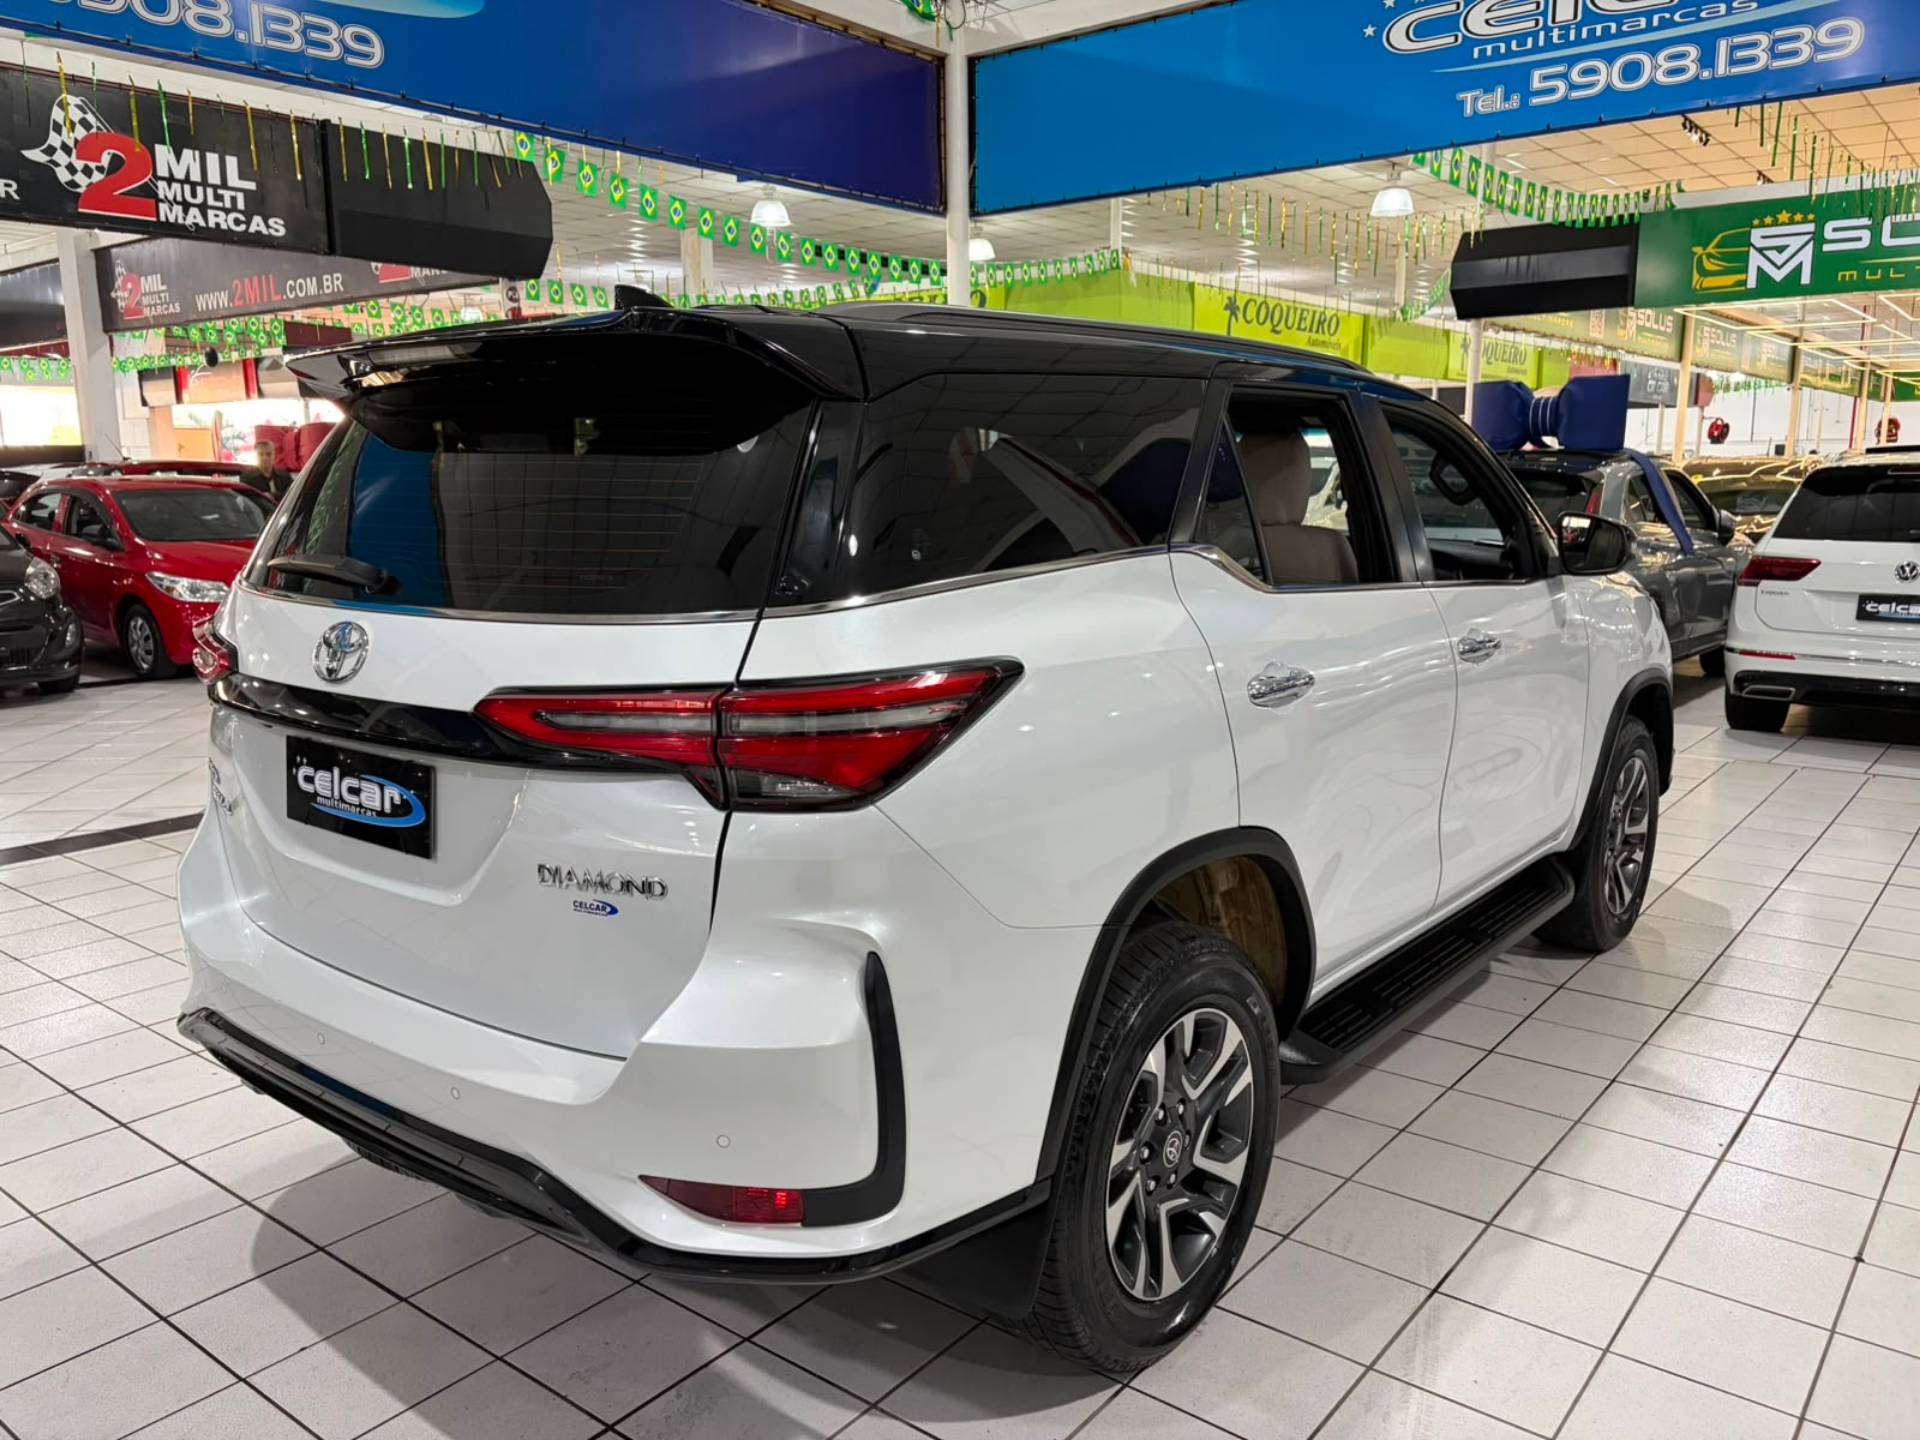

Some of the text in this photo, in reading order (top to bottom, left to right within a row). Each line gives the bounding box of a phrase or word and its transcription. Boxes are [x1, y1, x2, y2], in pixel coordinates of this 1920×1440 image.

[52, 0, 386, 69] 08.1339
[1472, 0, 1759, 59] multimarcas
[1456, 17, 1865, 118] Tel.: 5908.1339
[76, 131, 257, 222] 2 MIL
[157, 180, 246, 210] MULTI
[158, 202, 287, 237] MARCAS
[140, 273, 168, 293] MIL
[1242, 298, 1341, 337] COQUEIRO
[1636, 308, 1674, 333] SOLUS
[297, 765, 402, 814] celcar
[316, 795, 377, 818] multimarcas
[537, 863, 669, 901] DIAMOND
[572, 899, 608, 913] CELCAR
